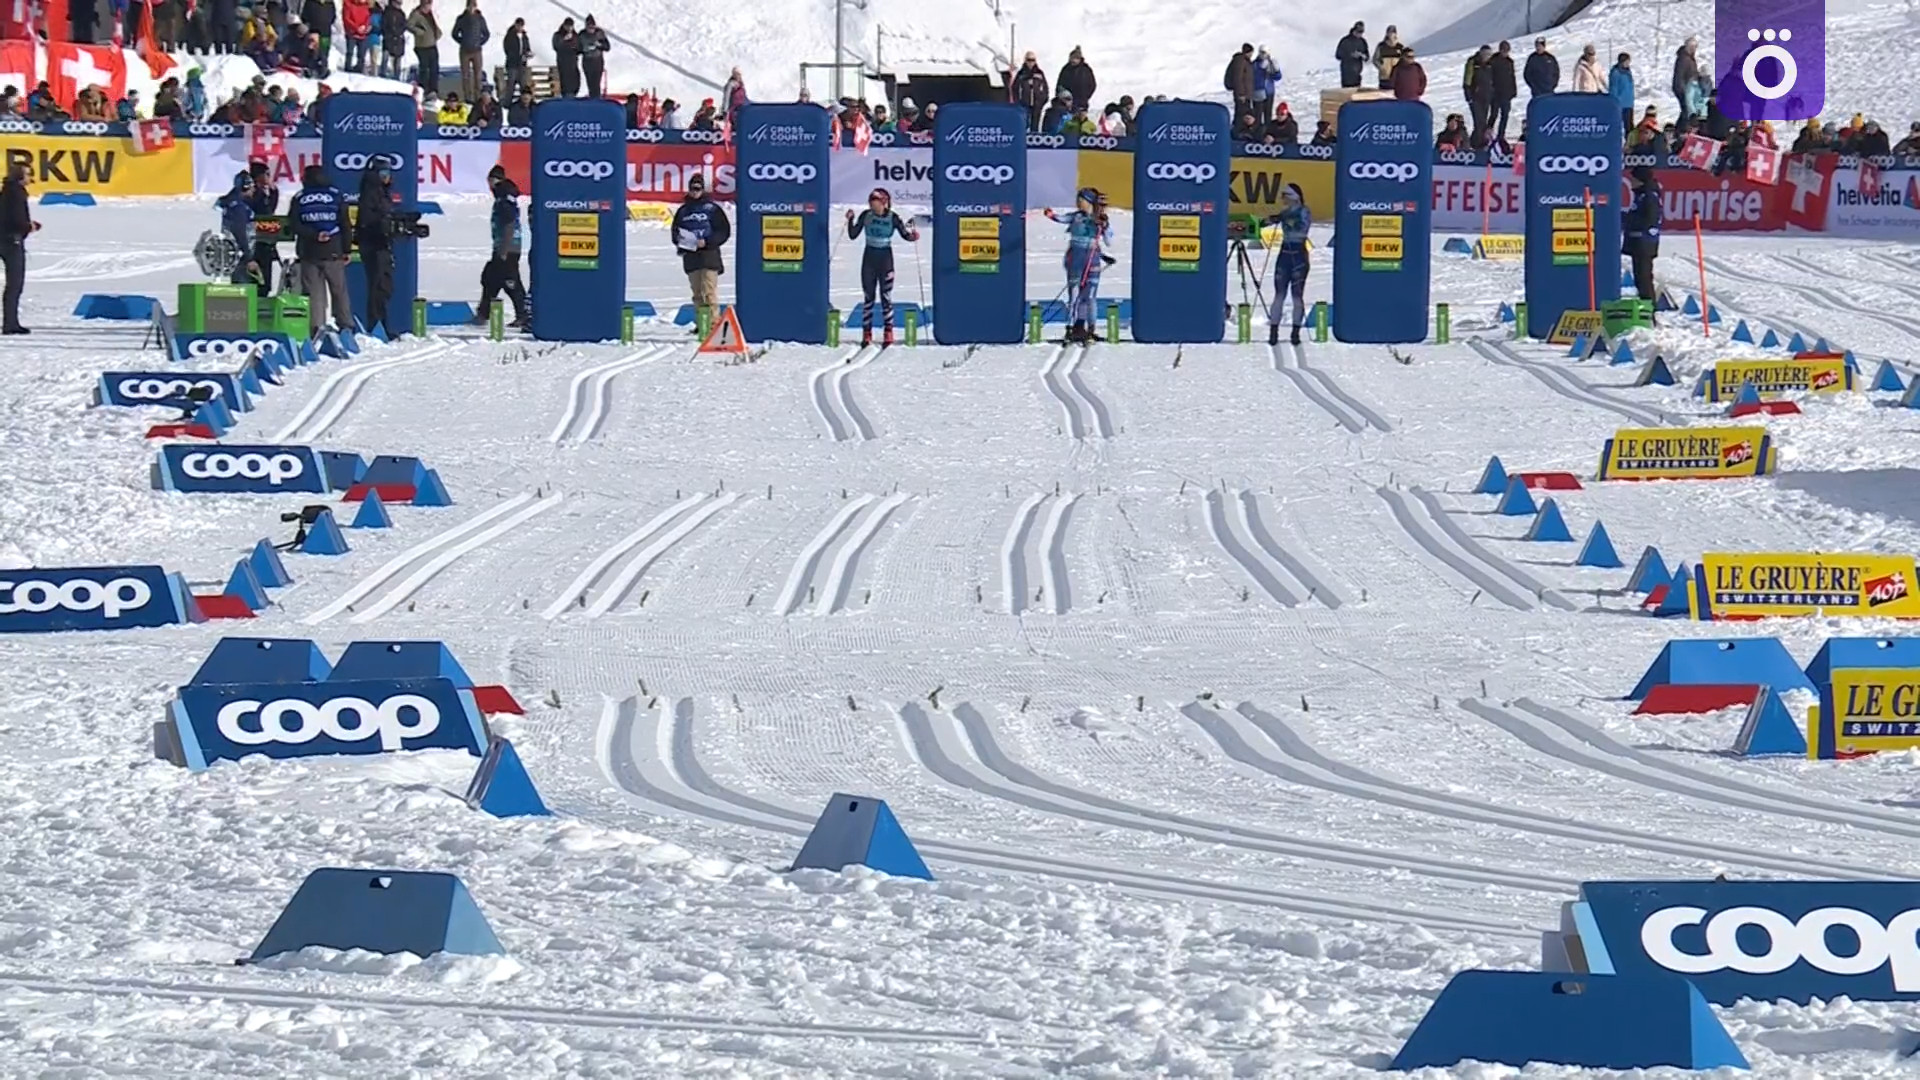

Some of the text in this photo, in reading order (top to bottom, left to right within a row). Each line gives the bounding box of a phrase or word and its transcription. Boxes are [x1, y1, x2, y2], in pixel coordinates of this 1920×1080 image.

[63, 121, 108, 136] coop
[189, 124, 234, 138] coop
[438, 125, 481, 140] coop
[500, 127, 532, 138] coo
[1027, 135, 1065, 149] coop
[1079, 136, 1118, 150] coop
[1245, 143, 1284, 158] coop
[1301, 145, 1332, 159] coop
[1440, 151, 1476, 165] coop
[544, 160, 614, 181] coop
[626, 153, 736, 193] unris
[1147, 162, 1216, 184] coop
[1350, 162, 1419, 183] coop
[1539, 155, 1610, 176] coop
[748, 164, 817, 184] coop
[945, 165, 1014, 185] coop
[1662, 179, 1763, 222] unrise
[570, 241, 596, 250] BKW
[775, 245, 800, 253] BKW
[971, 245, 997, 254] BKW
[1172, 244, 1197, 253] BKW
[1374, 244, 1399, 252] BKW
[1722, 363, 1810, 384] LE GRUYÈRE
[1618, 435, 1721, 458] LE GRUYÈRE
[182, 453, 303, 485] coop
[1621, 459, 1716, 469] SWITZERLAND
[1716, 562, 1861, 591] LE GRUYÈRE
[1721, 594, 1854, 604] SWITZERLAND
[1868, 583, 1907, 601] AOP
[1845, 684, 1885, 717] LE
[217, 694, 441, 751] coop
[1851, 722, 1920, 735] SWITZ
